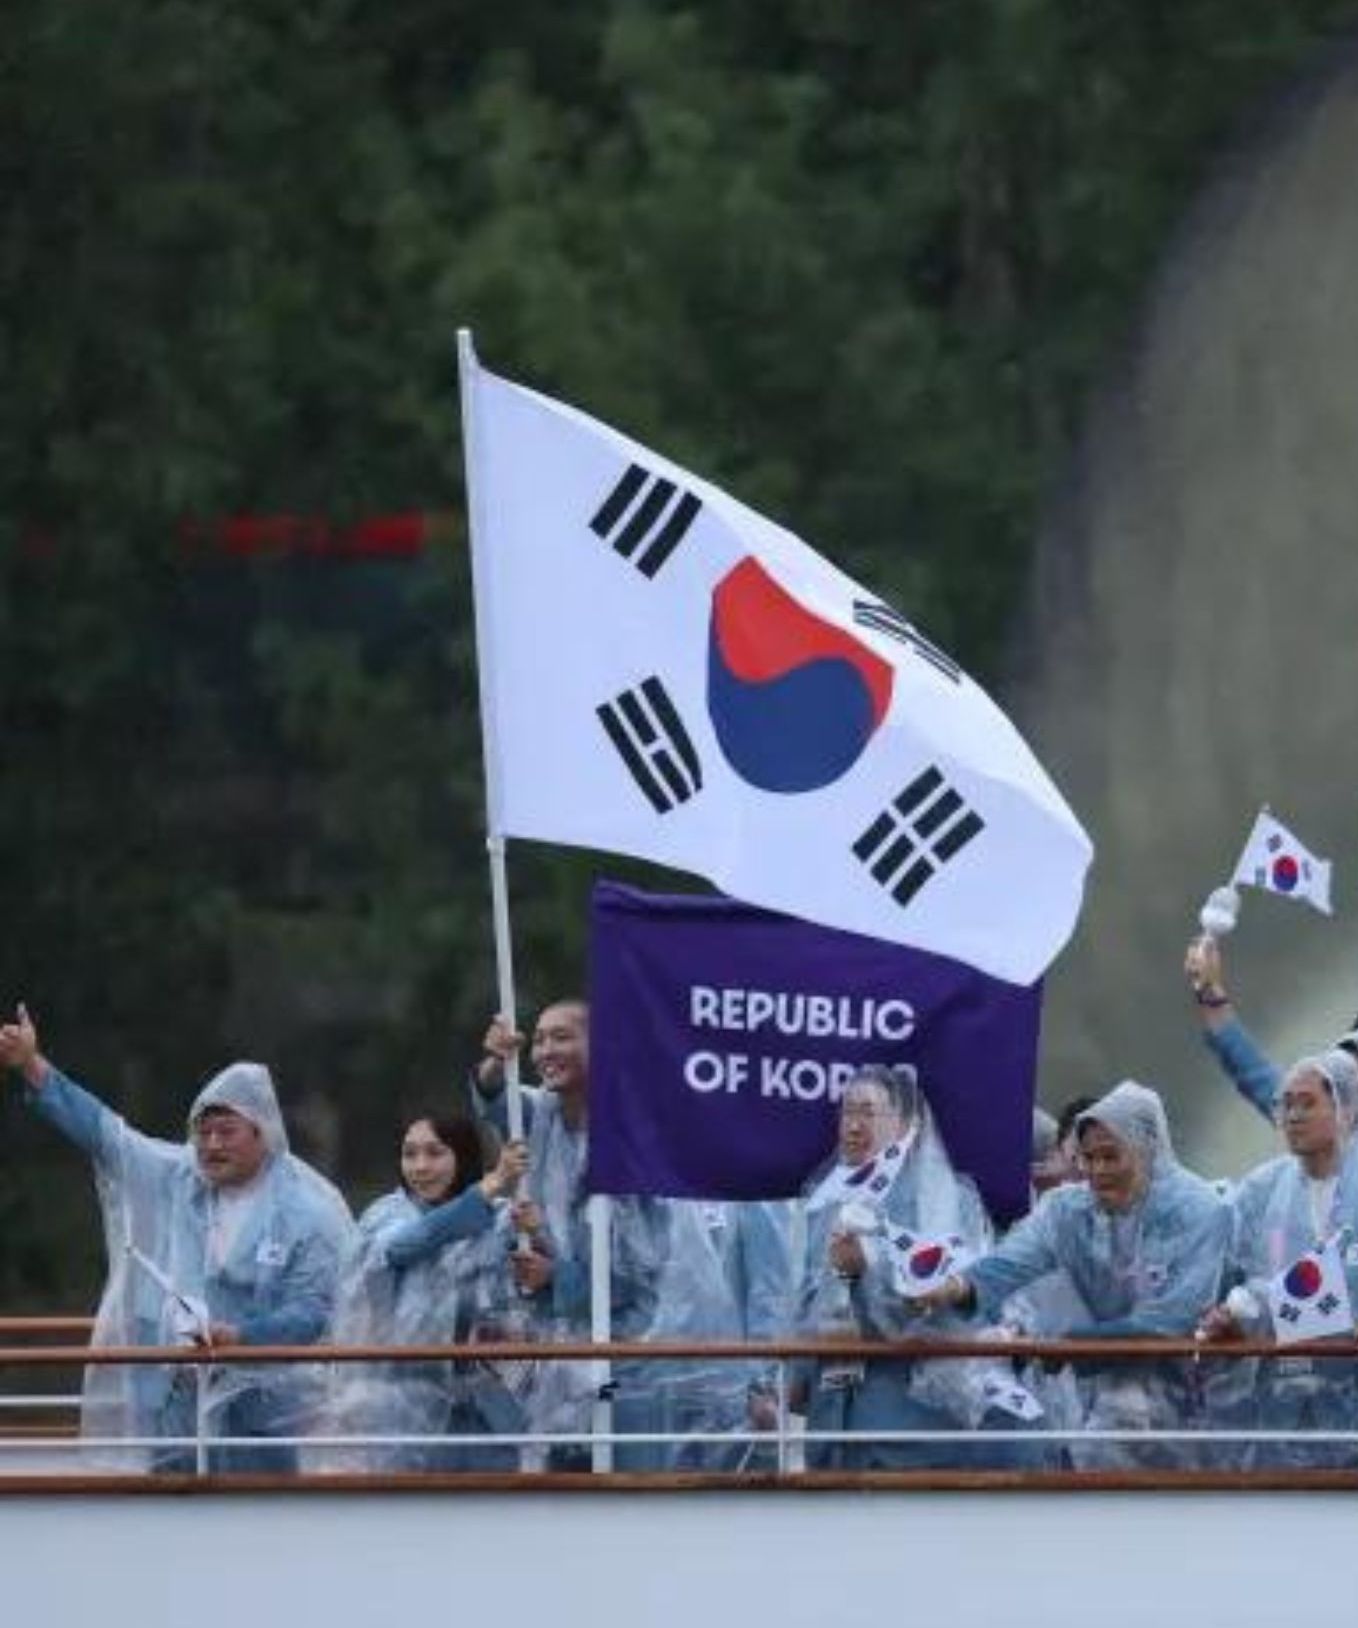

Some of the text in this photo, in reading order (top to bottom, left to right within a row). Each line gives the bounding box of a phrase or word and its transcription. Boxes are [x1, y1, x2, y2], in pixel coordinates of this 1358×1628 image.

[690, 986, 915, 1040] REPUBLIC
[685, 1051, 918, 1102] OF KOR
